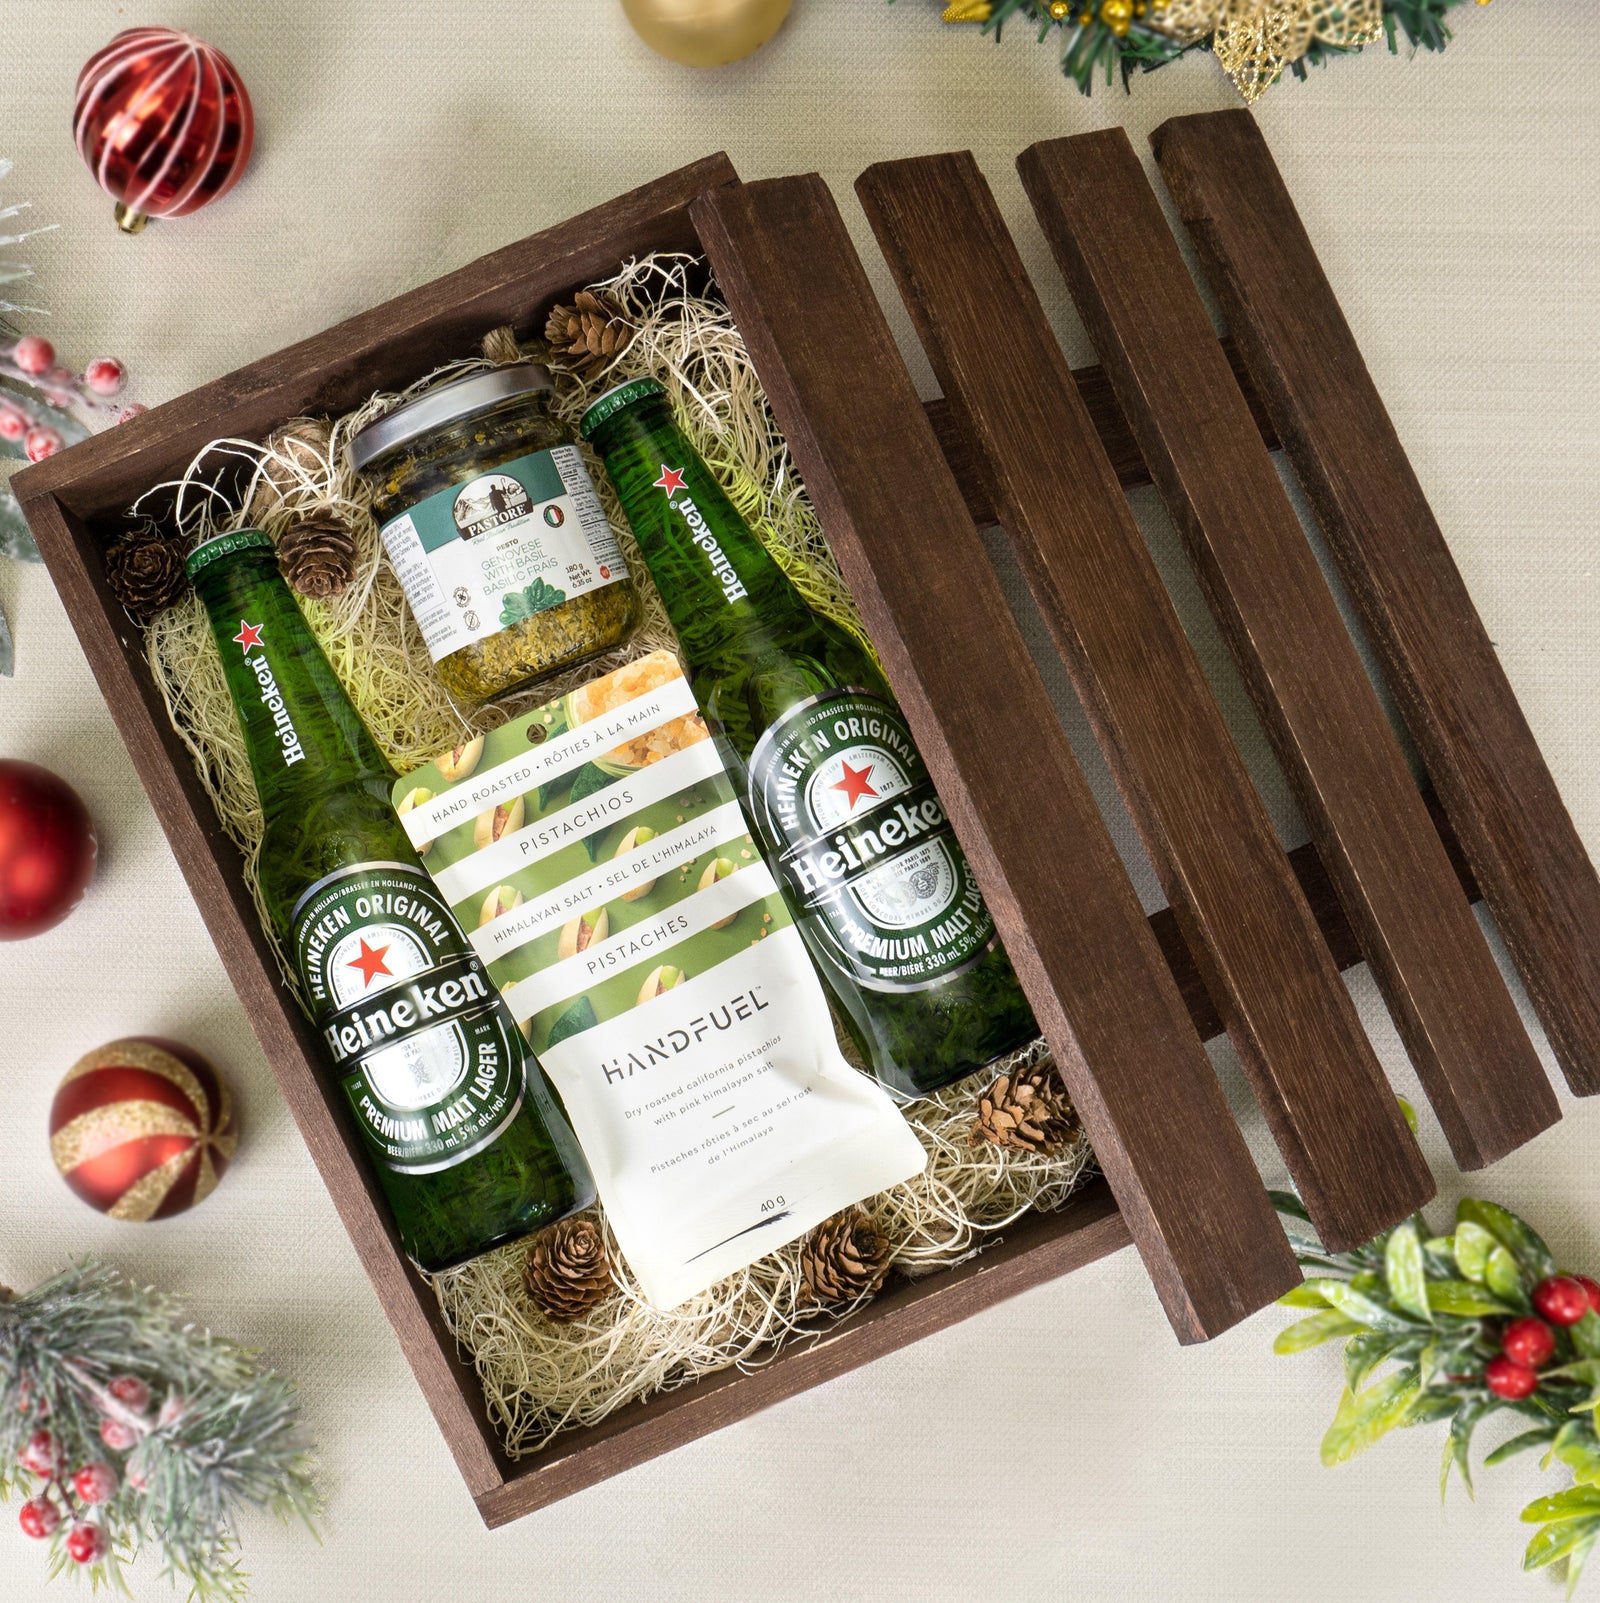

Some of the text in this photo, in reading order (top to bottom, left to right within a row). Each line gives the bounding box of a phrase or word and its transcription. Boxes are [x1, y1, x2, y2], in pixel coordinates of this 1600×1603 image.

[468, 504, 527, 537] PASTORE
[481, 538, 543, 571] GENOVESE
[496, 538, 519, 552] PESTO
[678, 497, 749, 605] Heineken
[483, 557, 559, 596] BASILIC FRAIS
[484, 550, 548, 581] WITH BASIL
[565, 563, 578, 574] 180
[569, 573, 581, 582] Net
[572, 579, 585, 589] 6.35
[251, 654, 306, 767] Heineken
[781, 740, 790, 749] IN
[845, 703, 854, 711] EN
[432, 703, 662, 824] HAND ROASTED RÔTIES À LA MAIN
[777, 717, 917, 832] HEINEKEN ORIGINAL
[880, 781, 895, 793] 1873
[519, 790, 634, 855] PISTACHIOS
[904, 853, 919, 864] PARIS
[904, 862, 919, 872] PARIS
[308, 911, 316, 921] IN
[381, 880, 417, 892] HOLLANDE
[493, 825, 718, 944] HIMALAYAN SALT SEL DE L'HIMALAYA
[306, 893, 450, 1000] HEINEKEN ORIGINAL
[586, 915, 689, 975] PISTACHES
[839, 919, 929, 960] PREMIUM
[930, 907, 973, 949] MALT
[925, 952, 946, 970] 330
[959, 935, 977, 952] 5%
[323, 969, 488, 1063] Heineken
[474, 1024, 491, 1035] MARK
[359, 1094, 430, 1142] PREMIUM
[431, 1094, 477, 1136] MALT
[469, 1042, 498, 1101] LAGER
[624, 1035, 782, 1120] Dry roasted california pistachios
[654, 1060, 774, 1126] with pink himalayan salt
[424, 1138, 444, 1154] 330
[459, 1125, 479, 1141] 5%
[650, 1147, 700, 1174] Pistaches
[702, 1130, 731, 1150] rôties
[742, 1114, 760, 1128] sec
[762, 1107, 774, 1117] au
[776, 1096, 791, 1110] sel
[707, 1154, 721, 1166] de
[760, 1194, 787, 1214] 40 g
